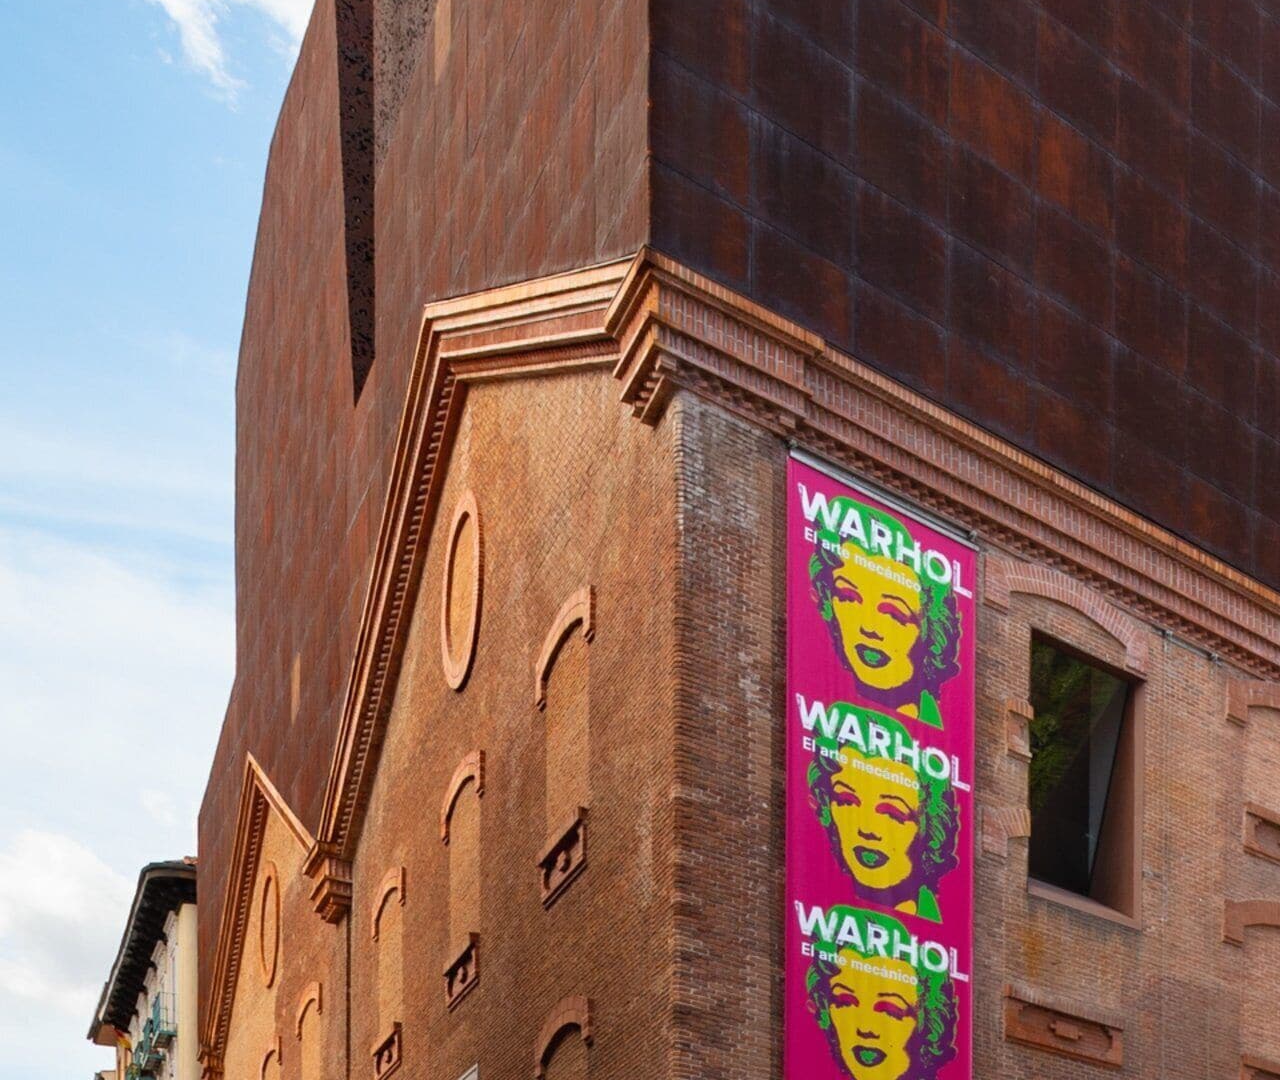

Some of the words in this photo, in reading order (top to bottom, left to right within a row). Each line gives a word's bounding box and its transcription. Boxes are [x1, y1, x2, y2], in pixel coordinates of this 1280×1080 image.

[797, 482, 972, 599] WARHOL
[804, 526, 817, 545] El
[822, 540, 850, 560] arte
[854, 554, 922, 593] mecánico
[795, 692, 971, 792] WARHOL
[802, 736, 816, 753] El
[820, 746, 849, 764] arte
[852, 757, 920, 790] mecánico
[794, 900, 969, 982] WARHOL
[801, 942, 815, 958] El
[819, 949, 846, 966] arte
[850, 957, 919, 986] mecánico
